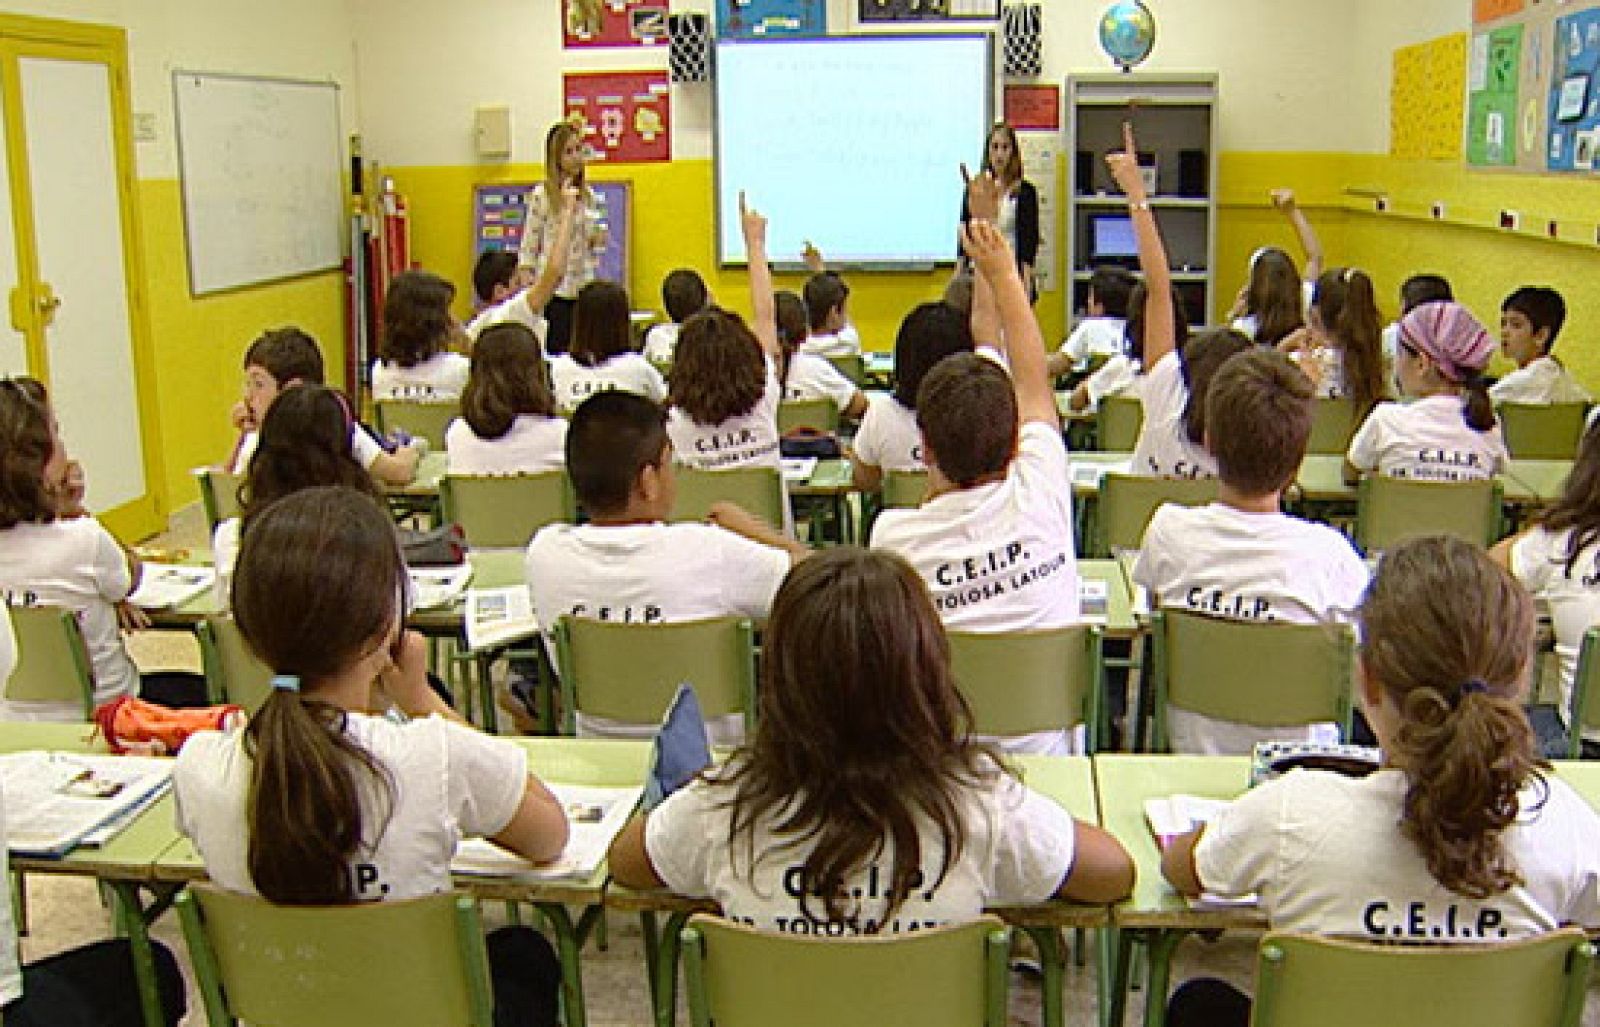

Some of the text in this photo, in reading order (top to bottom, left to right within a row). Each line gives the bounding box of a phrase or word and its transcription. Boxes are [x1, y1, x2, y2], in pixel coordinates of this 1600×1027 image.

[935, 552, 1066, 612] TOLOSA LATOUR
[936, 541, 1030, 586] C.E.I.P.
[1186, 587, 1275, 621] C.E.I.P.
[1363, 901, 1508, 938] C.E.I.P.
